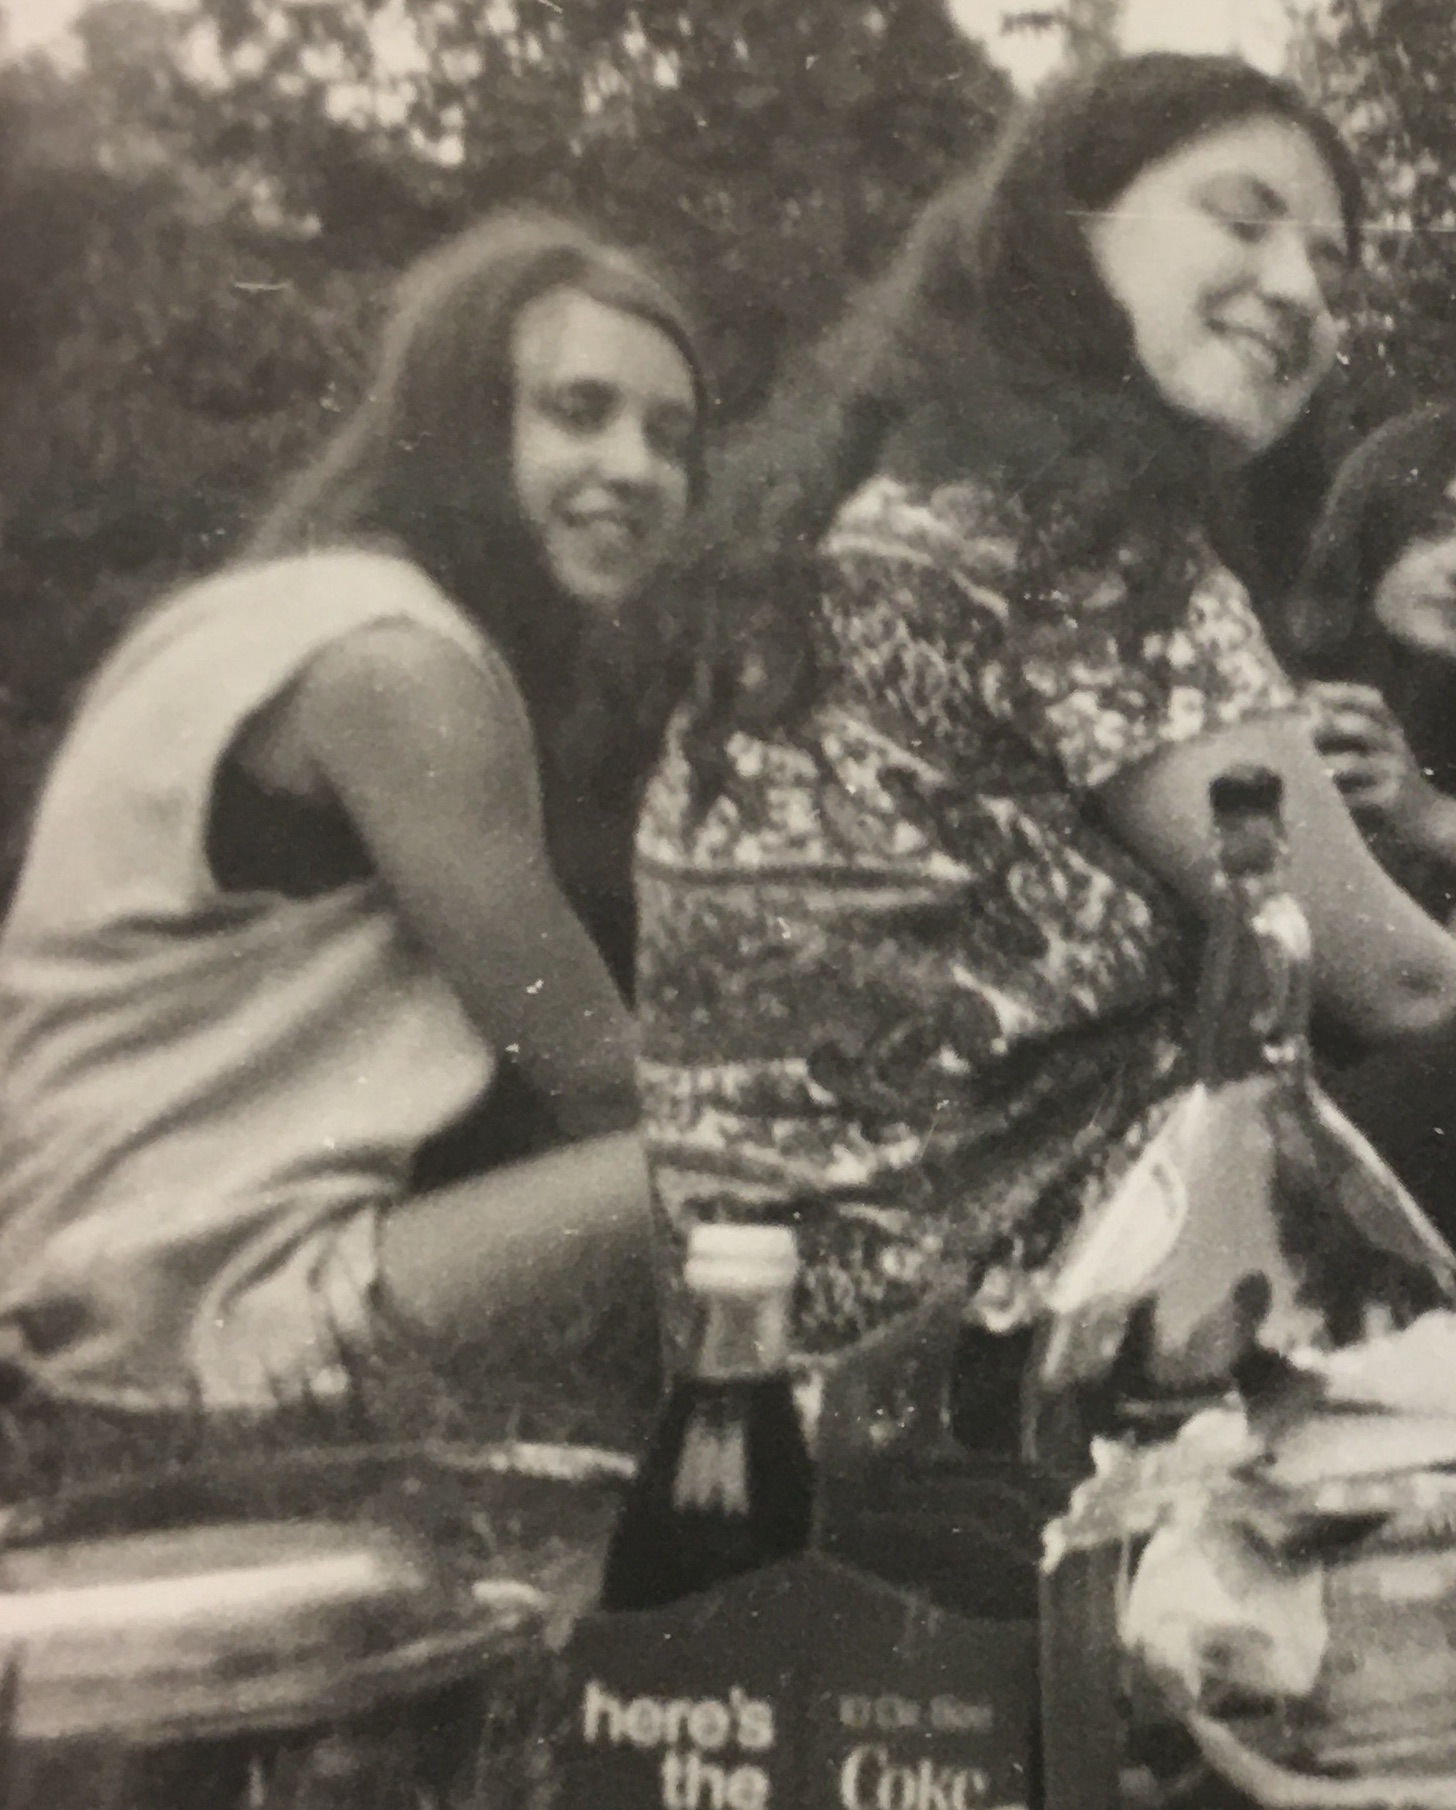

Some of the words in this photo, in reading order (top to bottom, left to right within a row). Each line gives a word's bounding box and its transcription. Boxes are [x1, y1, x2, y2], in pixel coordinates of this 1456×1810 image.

[583, 1681, 775, 1749] here's
[662, 1750, 770, 1810] the
[838, 1744, 988, 1810] Coke
